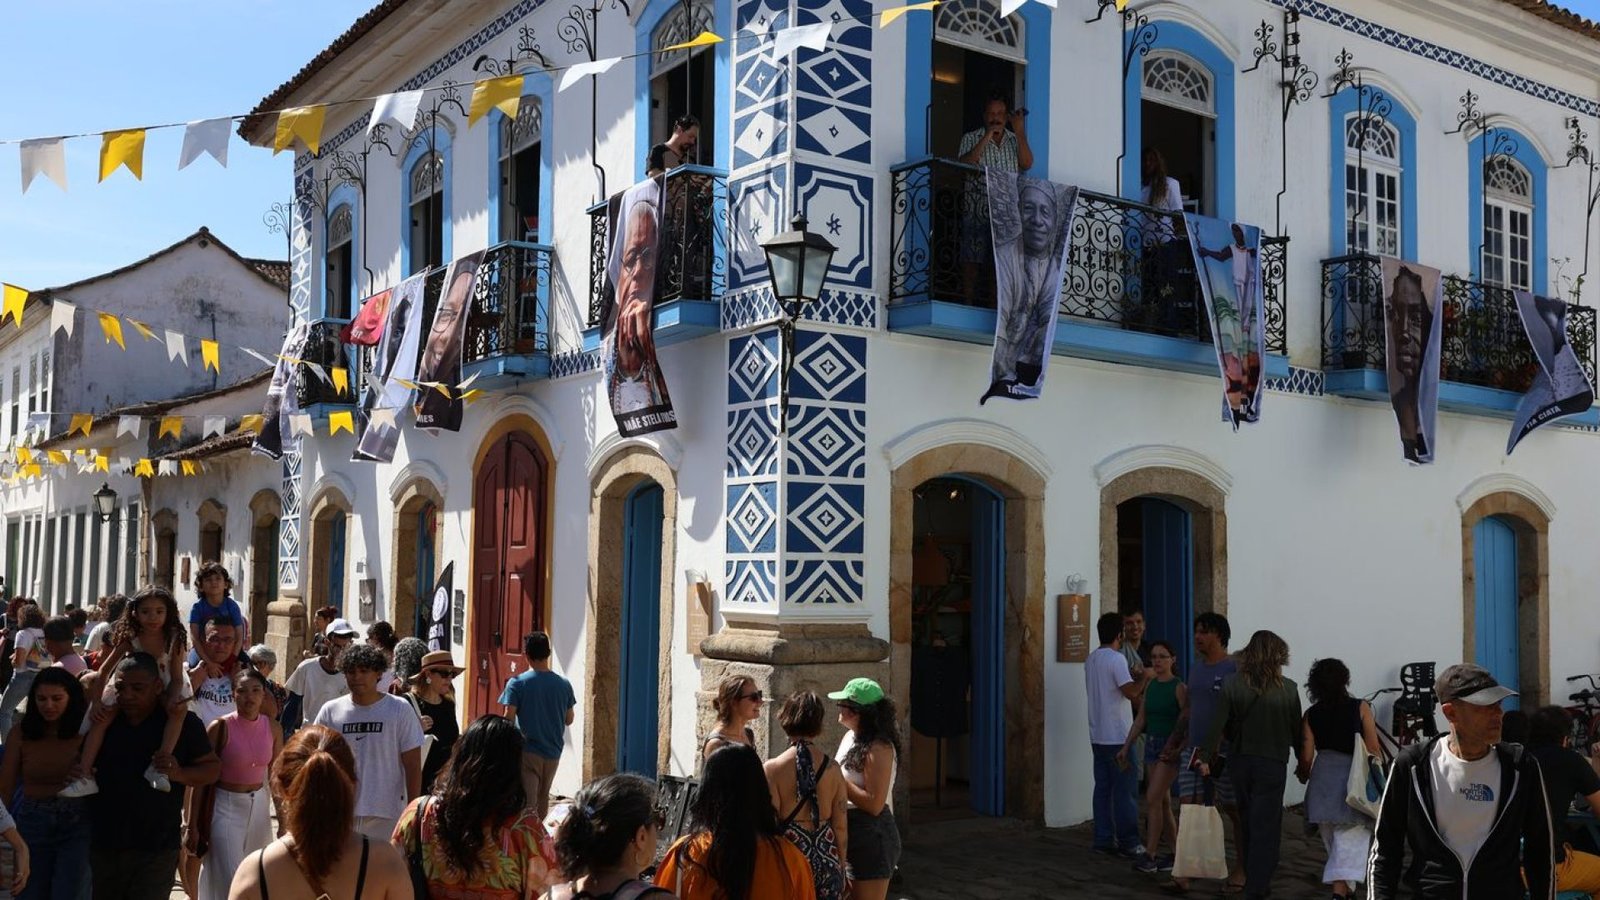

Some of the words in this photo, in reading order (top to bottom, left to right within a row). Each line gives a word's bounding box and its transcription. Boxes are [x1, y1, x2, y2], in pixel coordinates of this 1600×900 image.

[1526, 418, 1538, 429] TIA
[1538, 405, 1561, 420] CIATA
[624, 416, 642, 431] MÃE
[343, 723, 363, 732] NIKE
[366, 722, 382, 732] AIR
[1460, 787, 1482, 796] NORTH
